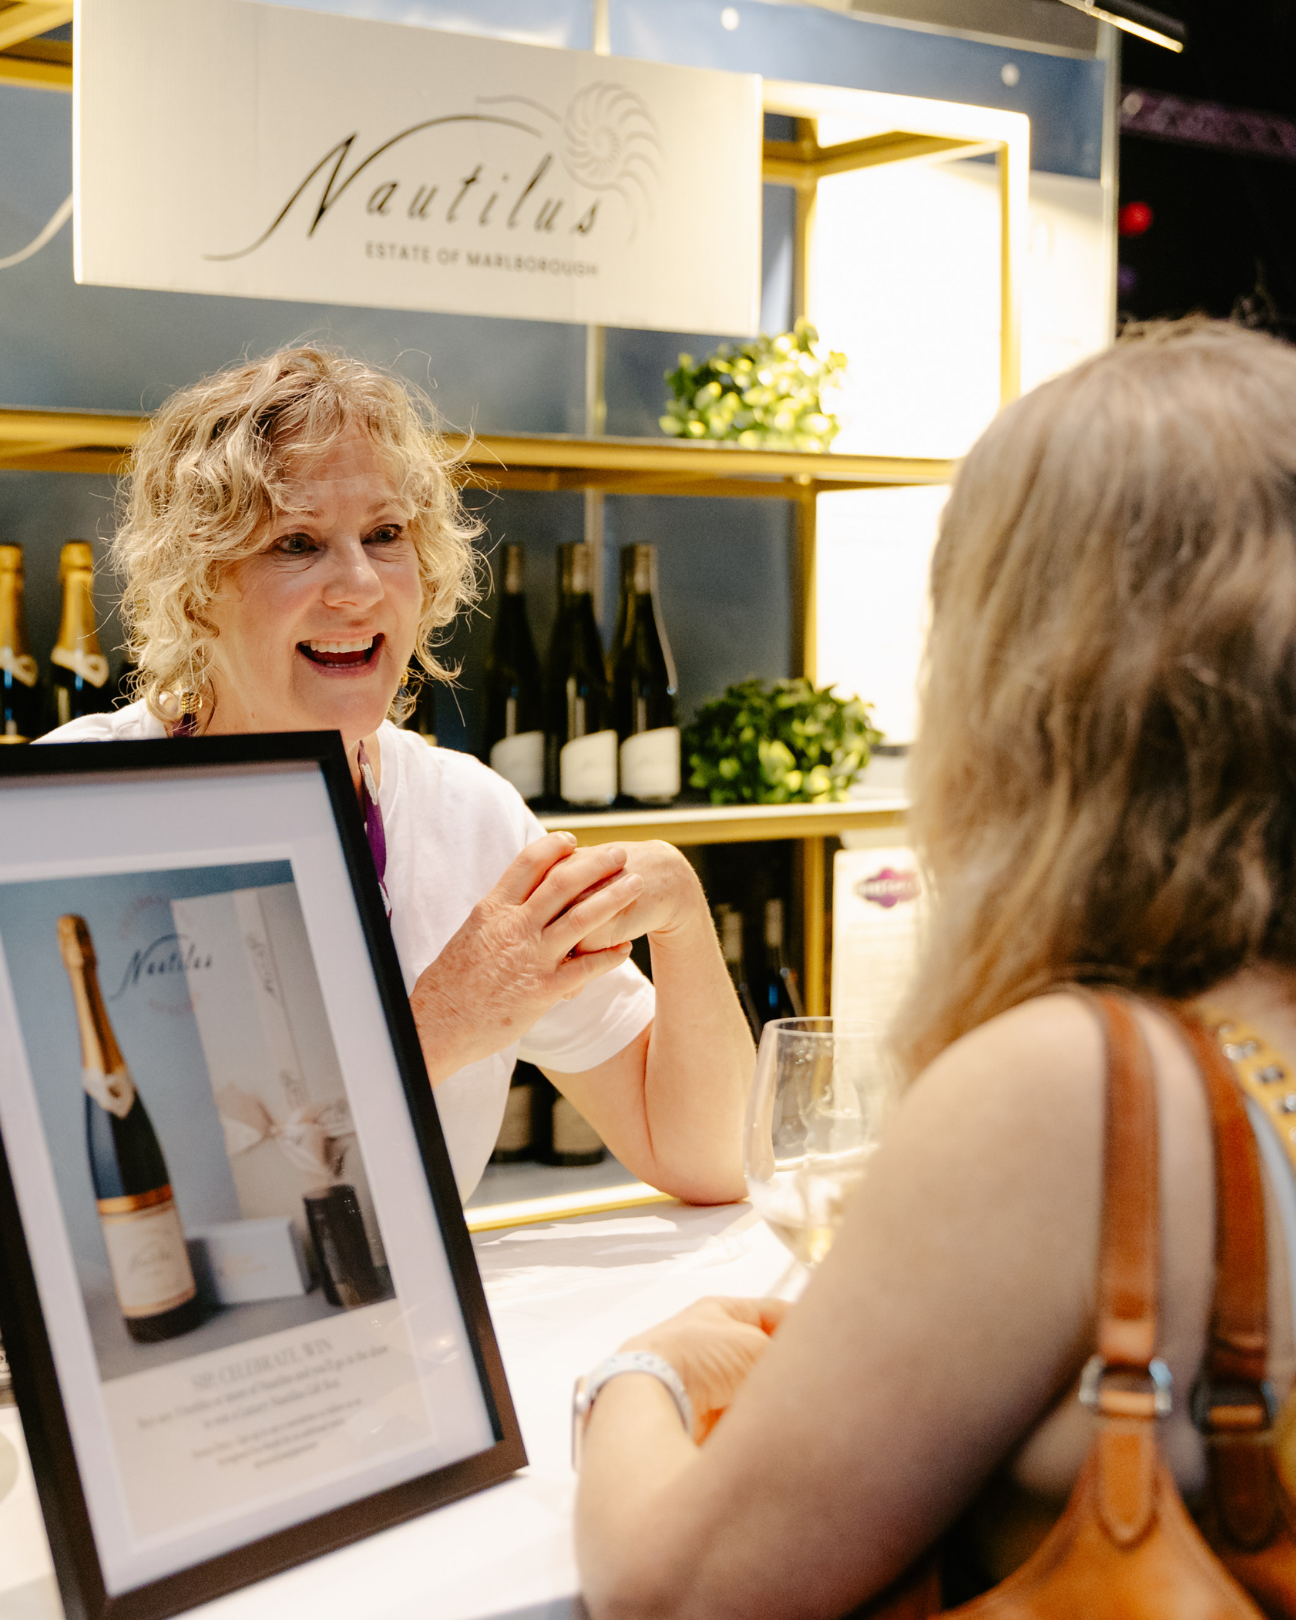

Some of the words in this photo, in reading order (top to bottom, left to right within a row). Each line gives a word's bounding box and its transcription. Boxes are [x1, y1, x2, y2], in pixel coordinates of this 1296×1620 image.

[203, 112, 600, 261] Nautilus
[365, 241, 431, 264] ESTATE
[438, 247, 461, 264] OF
[466, 250, 600, 278] MARLBOROUGH
